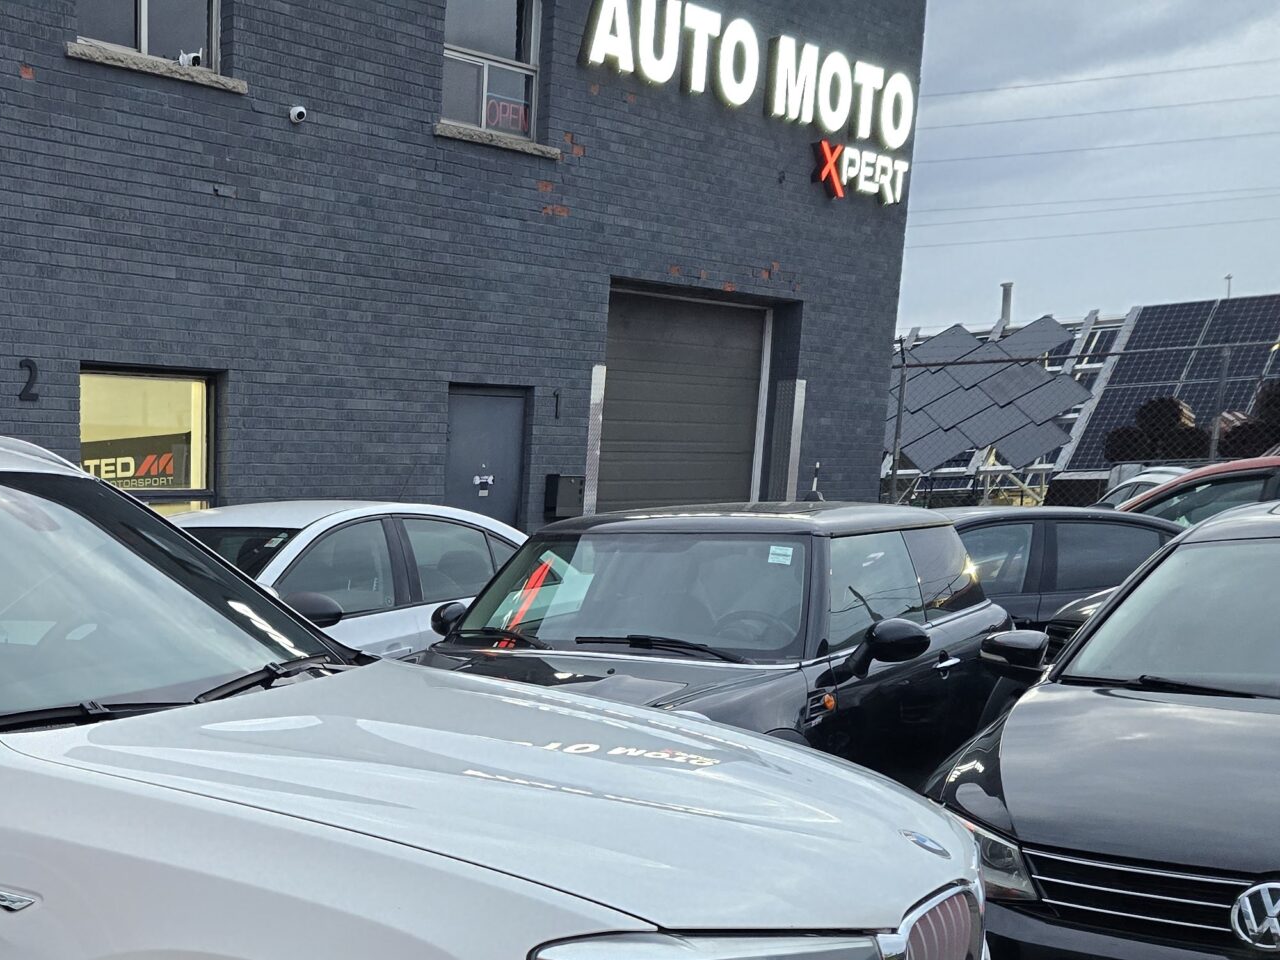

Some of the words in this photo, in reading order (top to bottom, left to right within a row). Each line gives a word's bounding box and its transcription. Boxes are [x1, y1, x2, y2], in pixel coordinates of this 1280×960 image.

[586, 0, 760, 106] AUTO
[770, 34, 915, 149] MOTO
[487, 99, 529, 132] OPEN
[821, 138, 910, 206] XPERT
[19, 358, 40, 401] 2
[553, 390, 560, 419] 1
[80, 456, 135, 479] TED
[109, 476, 174, 489] OTORSPORT
